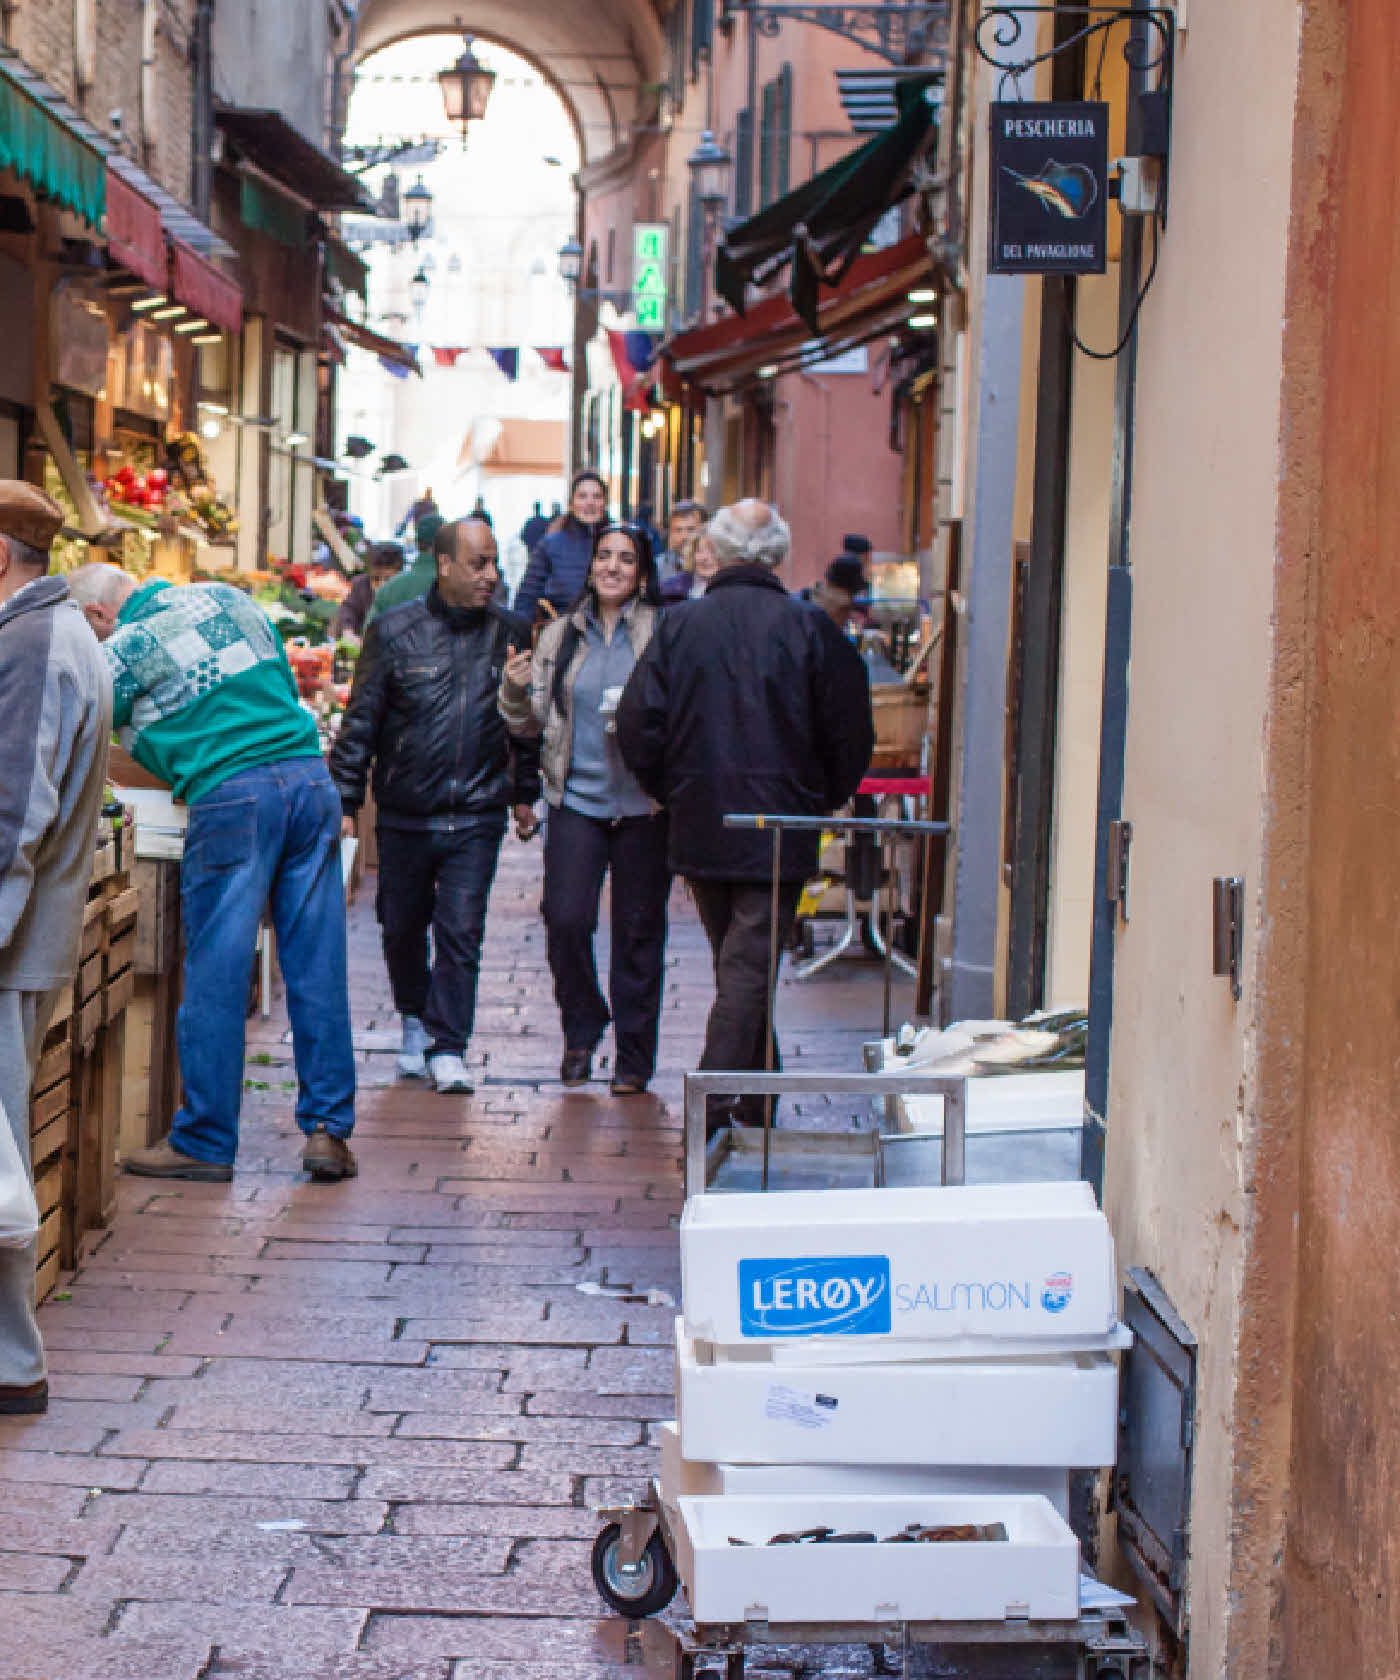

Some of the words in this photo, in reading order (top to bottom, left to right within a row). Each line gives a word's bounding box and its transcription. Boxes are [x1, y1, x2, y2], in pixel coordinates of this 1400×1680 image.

[1005, 119, 1096, 138] PESCHERIA
[1003, 244, 1022, 258] DEL
[1027, 244, 1096, 258] PAVAGLIONE
[753, 1277, 877, 1311] LERØY
[896, 1280, 1031, 1312] SALMON
